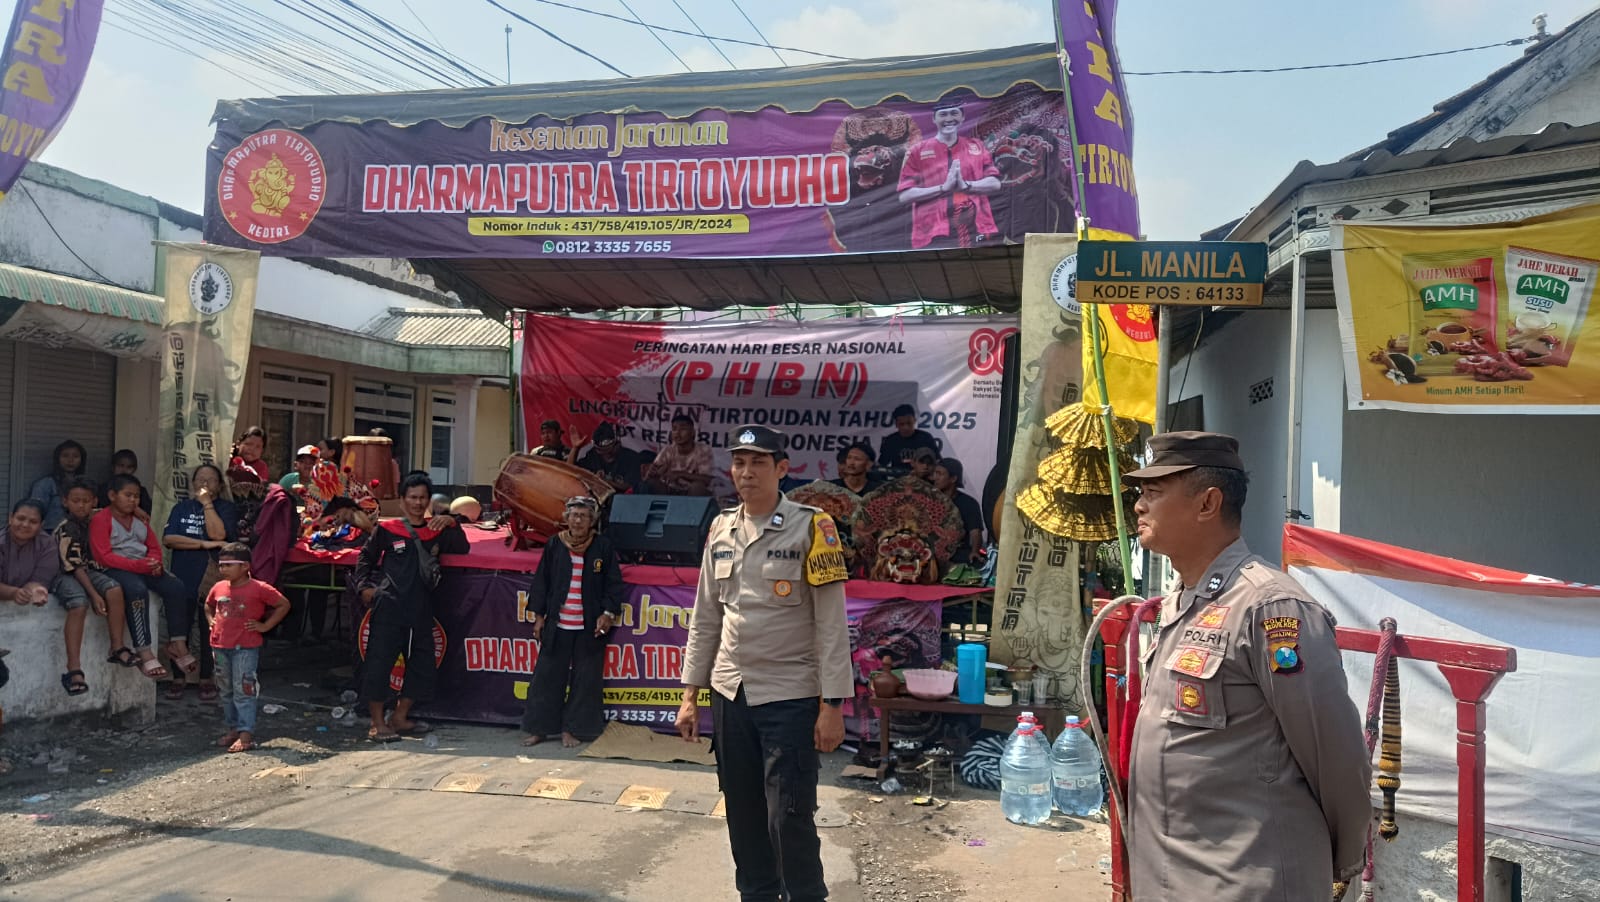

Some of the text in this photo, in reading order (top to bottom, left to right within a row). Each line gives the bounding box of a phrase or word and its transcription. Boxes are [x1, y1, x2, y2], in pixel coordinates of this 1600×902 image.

[490, 114, 728, 157] Kesenian Jaranan
[284, 135, 321, 201] TIRTOYUDHO
[362, 154, 850, 213] DHARMAPUTRA TIRTOYUDHO
[248, 223, 290, 239] KEDIRI
[483, 221, 523, 231] Nomor
[526, 221, 561, 231] Induk
[571, 218, 732, 232] 431/758/419.105/JR/2024
[556, 240, 671, 254] 0812 3335 7655
[1094, 250, 1247, 278] JL. MANILA
[1518, 259, 1579, 277] JAHE MERAH
[1093, 285, 1139, 299] KODE
[1146, 286, 1180, 300] POS
[1196, 287, 1244, 301] 64133
[1424, 286, 1475, 304] AMH
[1520, 277, 1567, 298] AMH
[1525, 296, 1554, 310] SUSU
[634, 341, 906, 355] PERINGATAN HARI BESAR NASIONAL
[1454, 386, 1473, 395] AMH
[1475, 386, 1502, 396] Setiap
[569, 398, 977, 430] LINGKUNGAN TIRTOUDAN TAHU 2025
[767, 550, 801, 559] POLRI
[1184, 630, 1222, 646] POLRI
[621, 710, 655, 721] 3335
